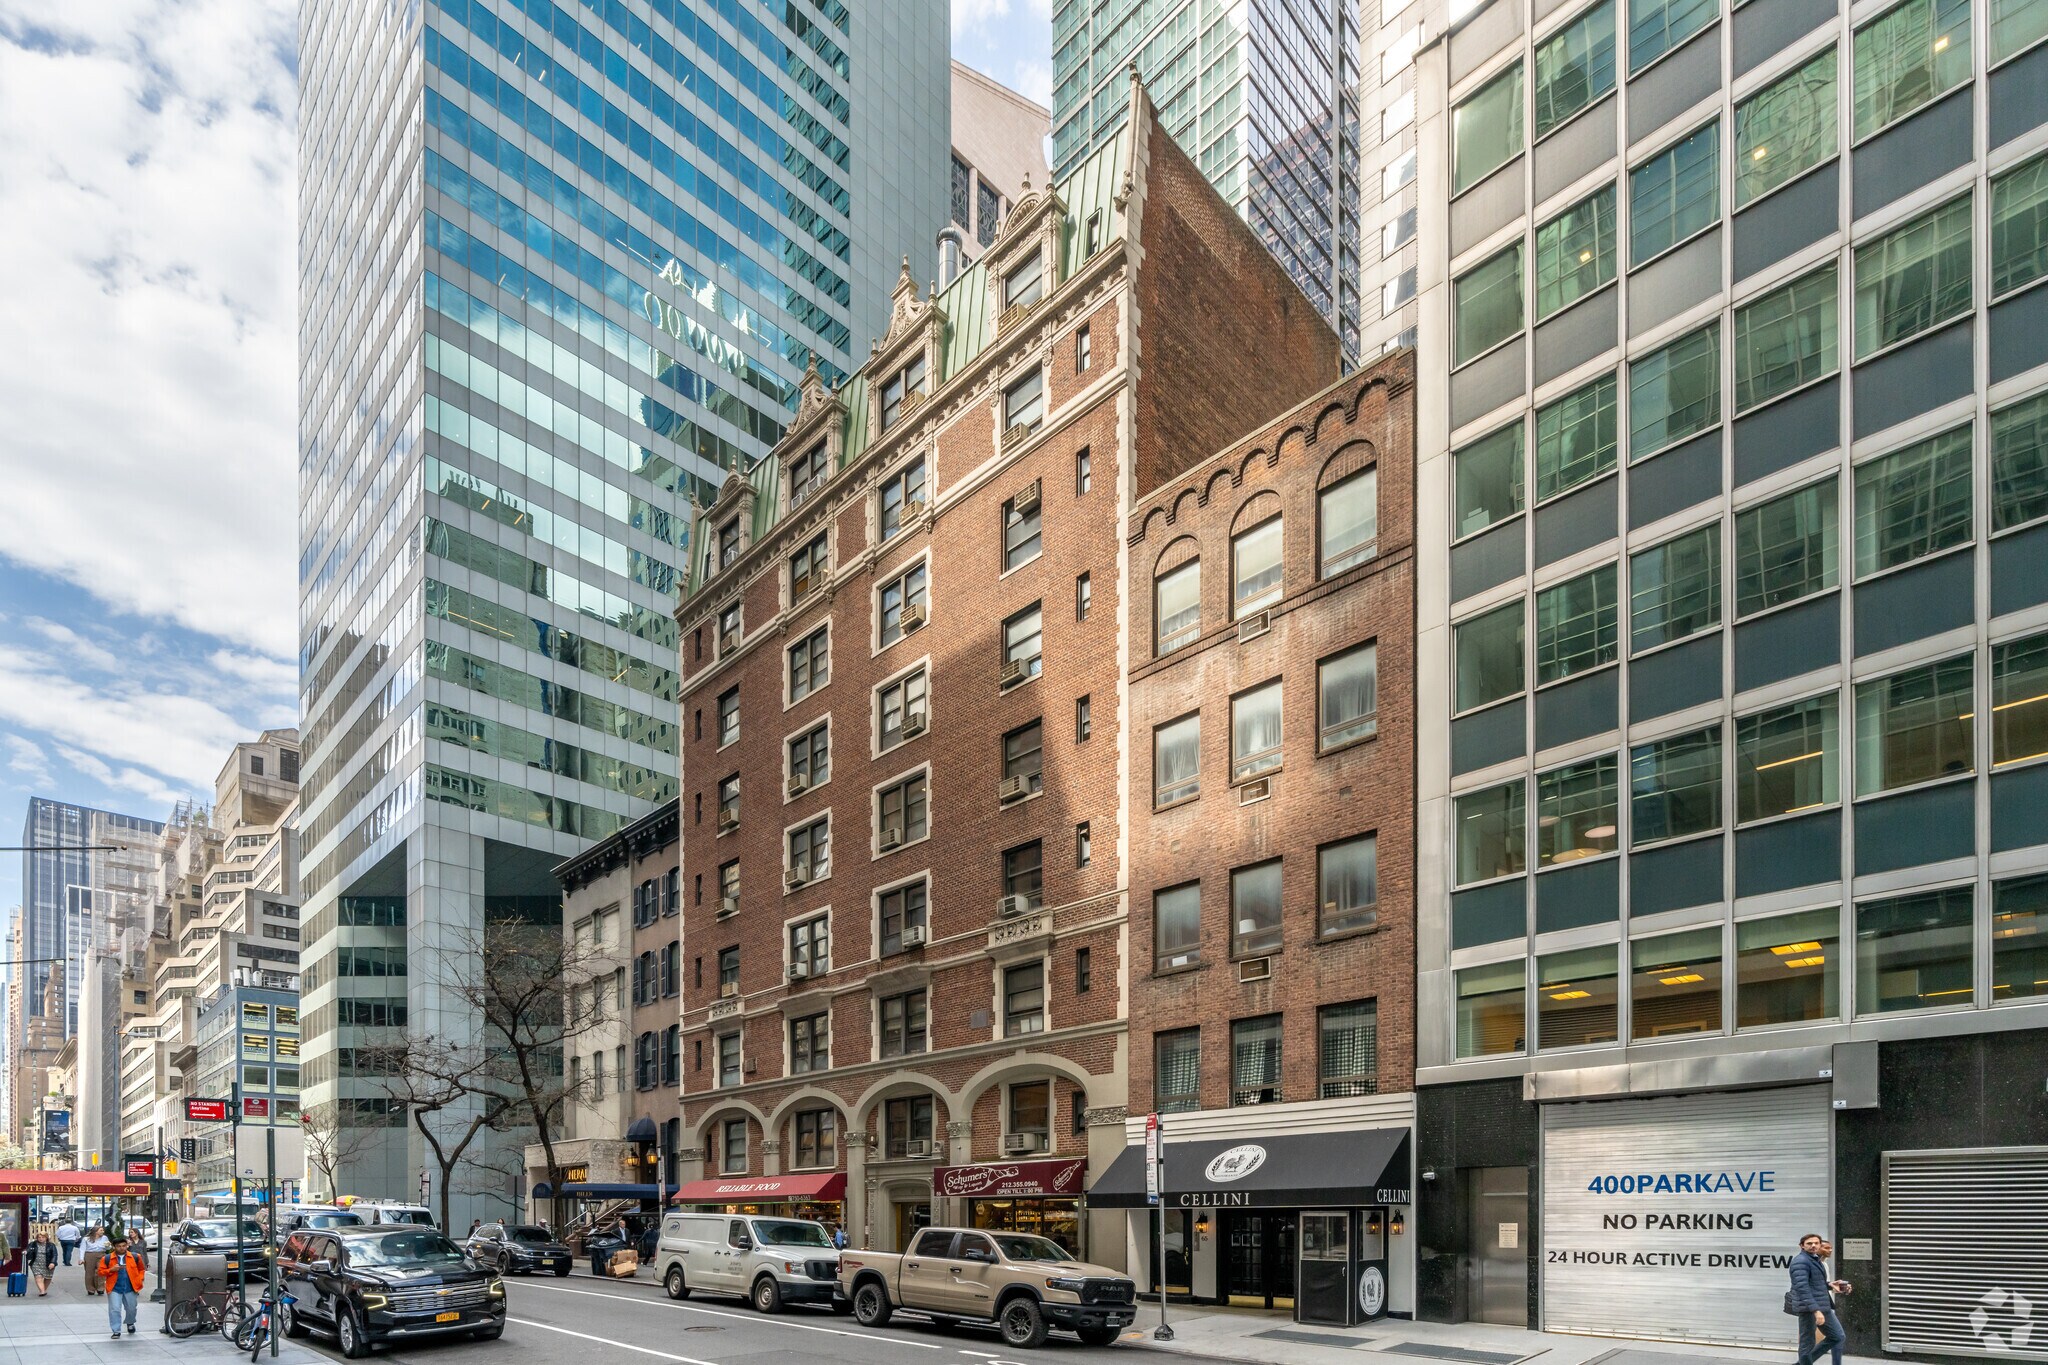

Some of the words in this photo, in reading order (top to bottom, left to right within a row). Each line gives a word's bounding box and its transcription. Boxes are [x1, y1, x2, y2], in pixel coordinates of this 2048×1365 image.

[947, 1169, 988, 1187] Schumer's
[9, 1184, 50, 1192] HOTEL
[53, 1184, 93, 1193] ELYSÉE
[715, 1184, 755, 1193] RELIABLE
[755, 1182, 781, 1191] FOOD
[1180, 1192, 1250, 1206] CELLINI
[1376, 1188, 1410, 1203] CELLINI
[1603, 1214, 1638, 1230] NO
[1645, 1213, 1754, 1230] PARKING
[1547, 1250, 1568, 1264] 24
[1573, 1251, 1628, 1266] HOUR
[1632, 1252, 1702, 1267] ACTIVE
[1708, 1253, 1794, 1269] DRIVEW
